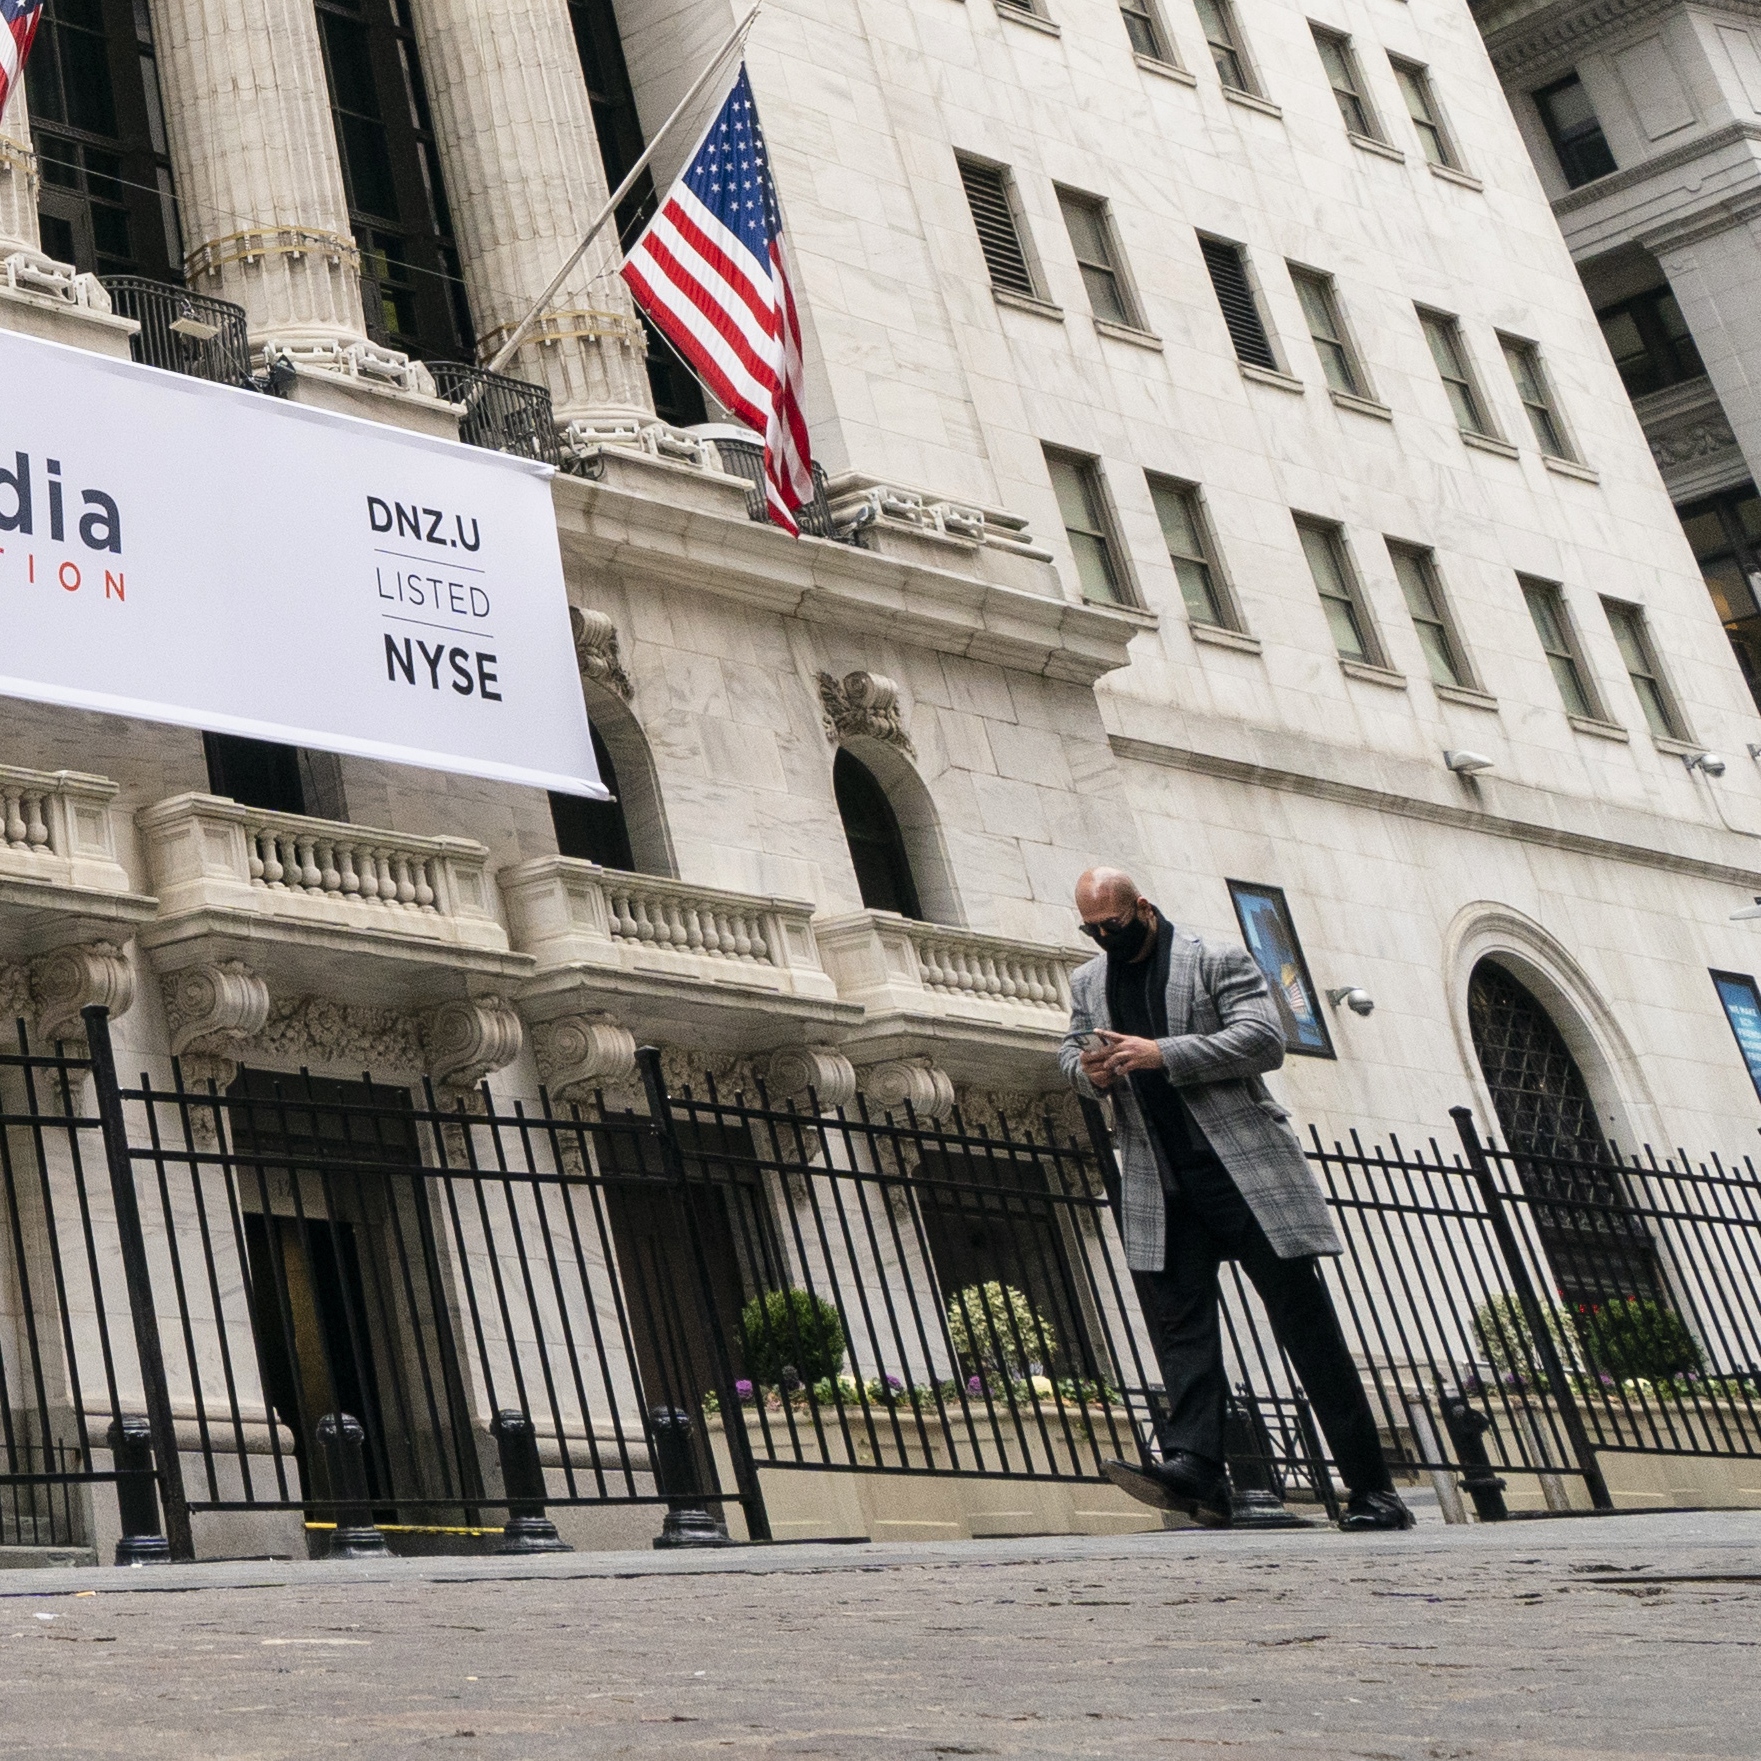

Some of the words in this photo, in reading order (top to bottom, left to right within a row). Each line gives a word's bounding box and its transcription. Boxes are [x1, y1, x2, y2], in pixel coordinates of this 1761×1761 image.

[366, 495, 481, 552] DNZ.U
[376, 567, 490, 618] LISTED
[384, 633, 503, 702] NYSE
